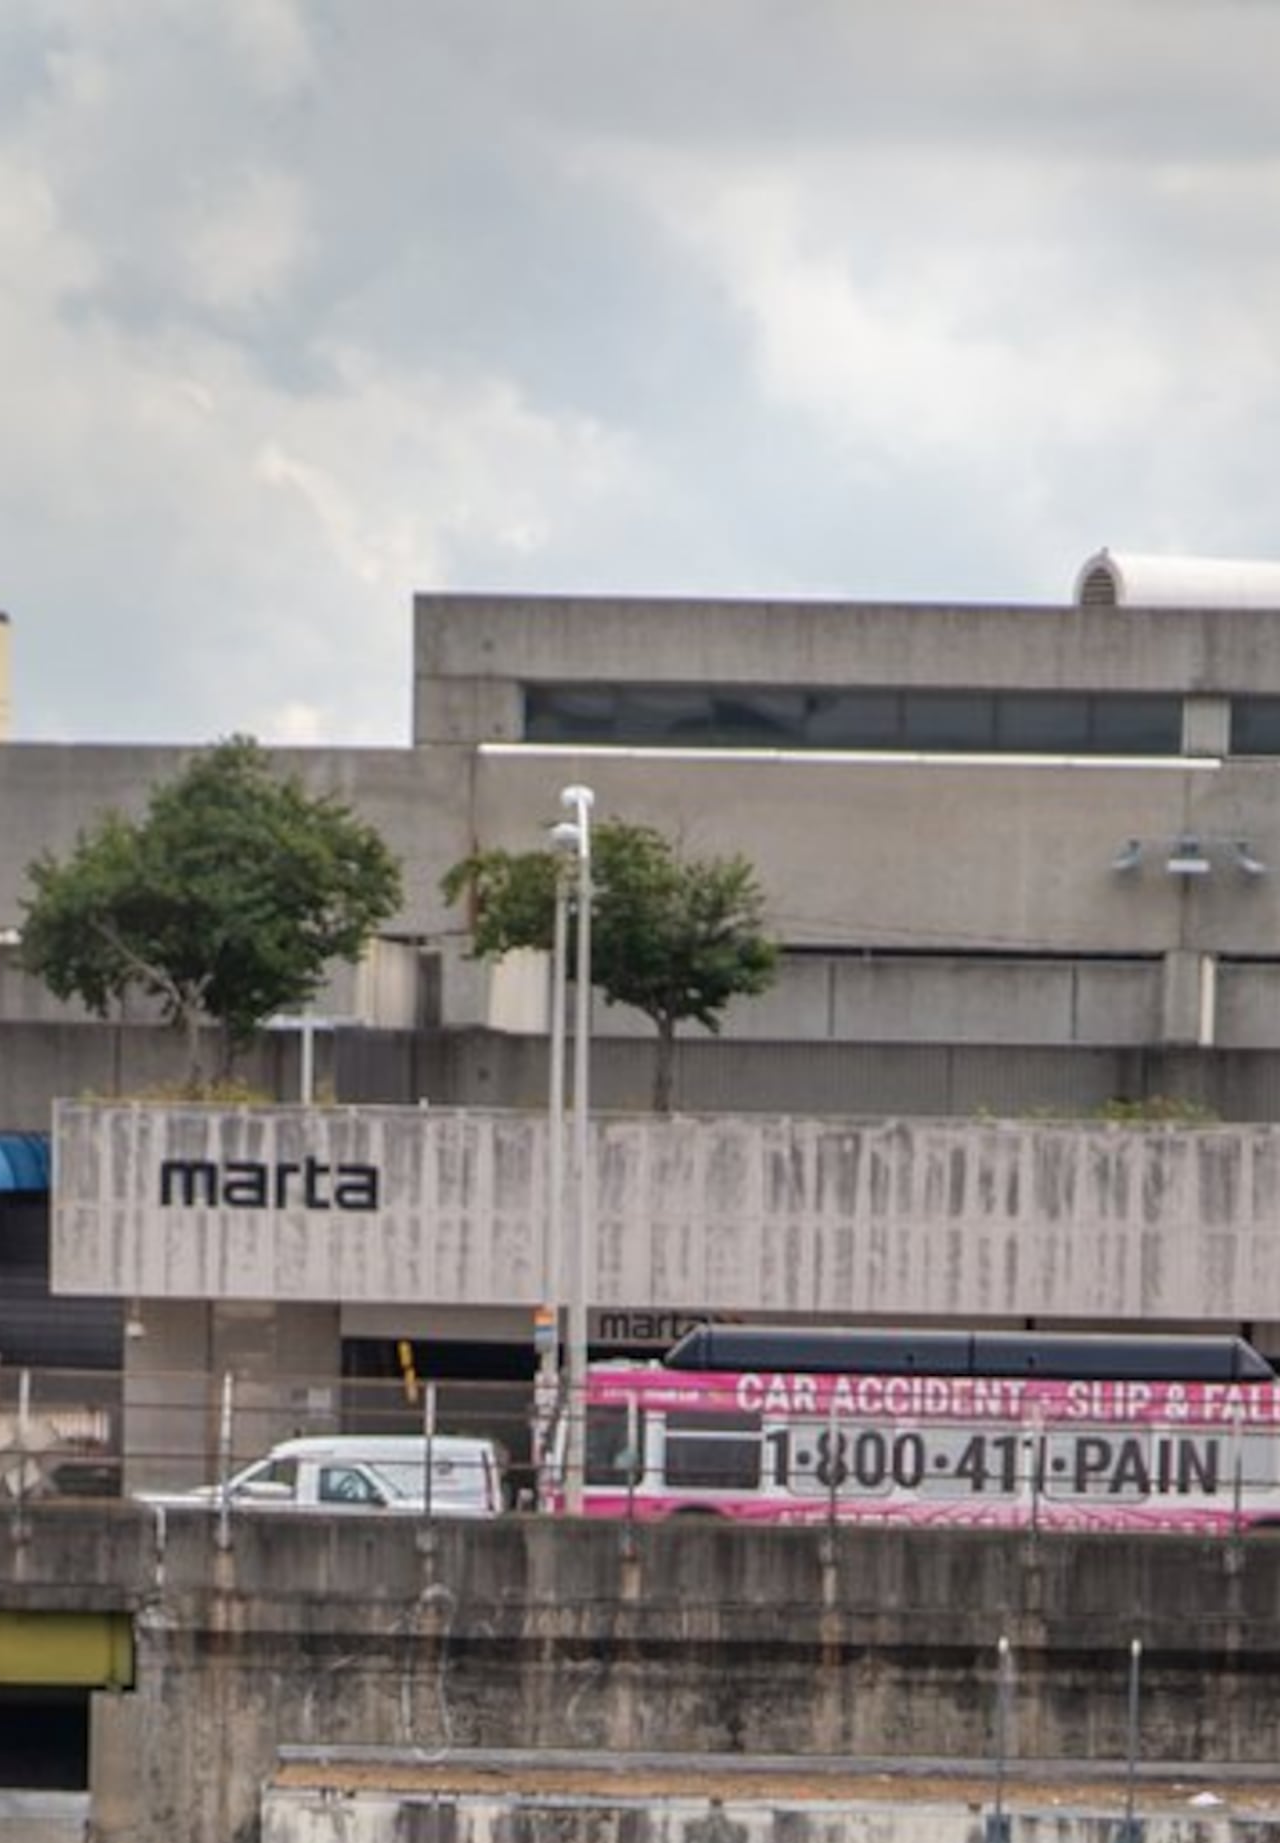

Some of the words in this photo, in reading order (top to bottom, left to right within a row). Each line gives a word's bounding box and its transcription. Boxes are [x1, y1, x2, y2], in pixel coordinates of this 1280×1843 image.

[161, 1156, 379, 1210] marta
[736, 1374, 817, 1413] CAR
[834, 1376, 1025, 1417] ACCIDENT
[1066, 1381, 1151, 1418] SLIP
[1167, 1384, 1188, 1419] &
